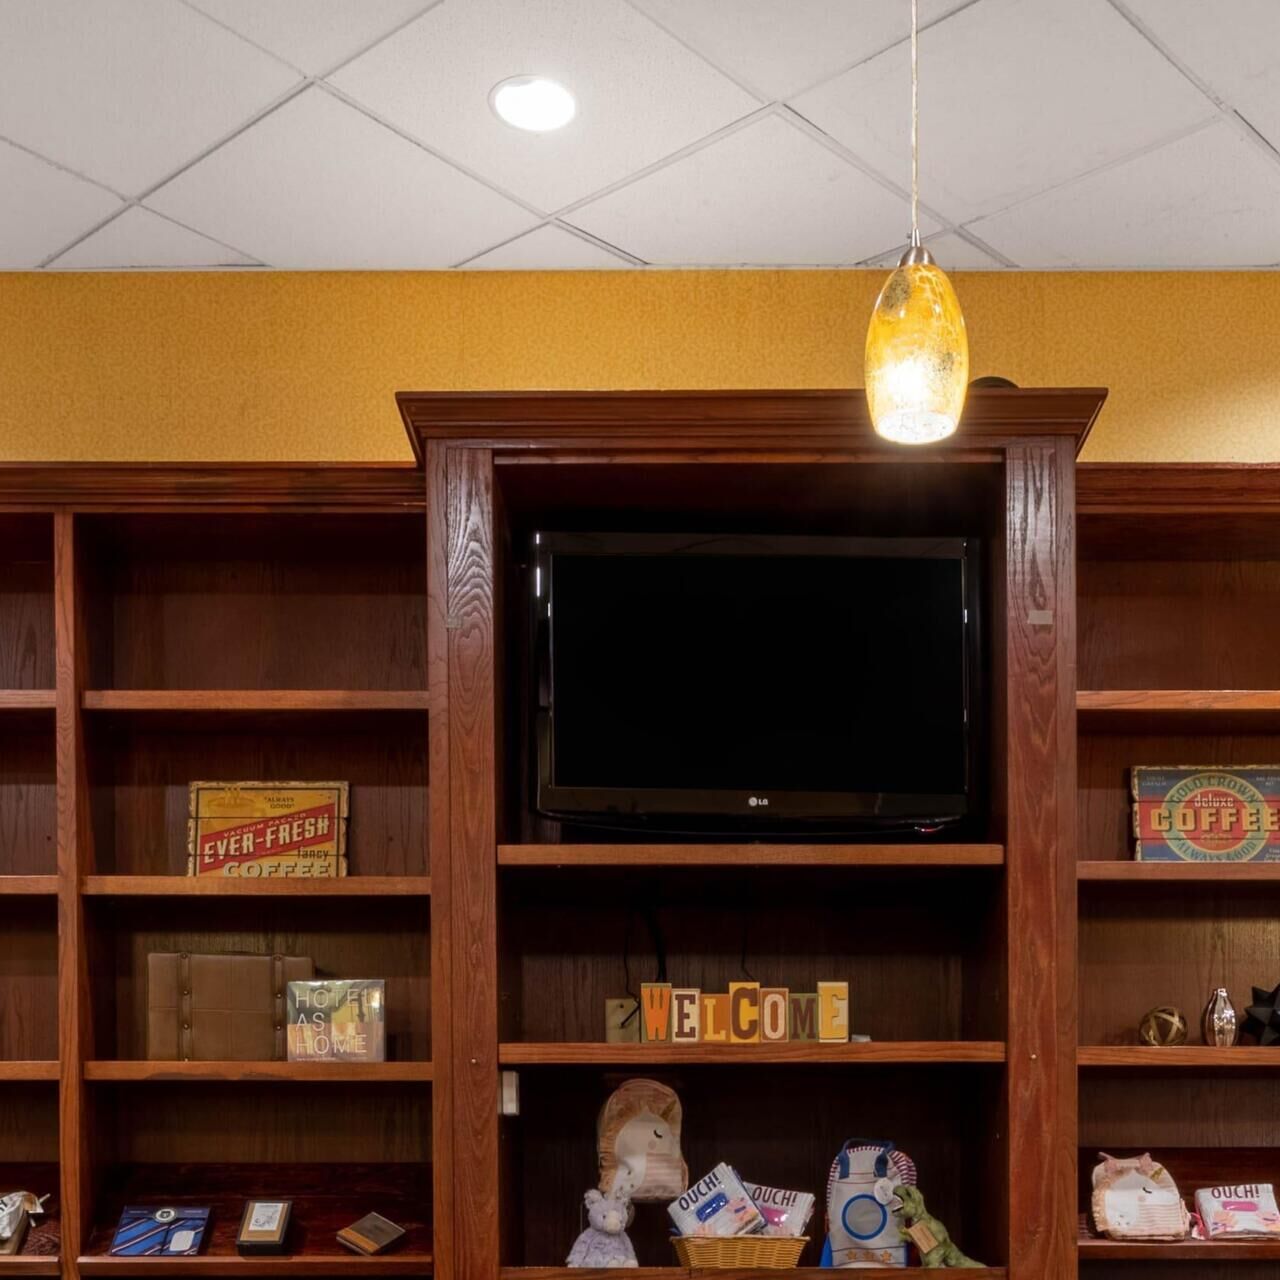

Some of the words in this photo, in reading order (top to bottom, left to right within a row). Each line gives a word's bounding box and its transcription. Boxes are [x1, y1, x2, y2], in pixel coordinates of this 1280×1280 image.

[1207, 775, 1260, 804] CROWN
[1194, 793, 1234, 808] deluxe
[204, 815, 330, 864] EVER-FRESH
[297, 846, 329, 861] fancy
[295, 988, 373, 1009] HOTEL
[296, 1012, 325, 1032] AS
[641, 986, 848, 1041] WELCOME
[296, 1034, 368, 1054] HOME
[679, 1172, 722, 1211] OUCH!
[752, 1187, 798, 1207] OUCH!
[1211, 1185, 1260, 1198] OUCH!
